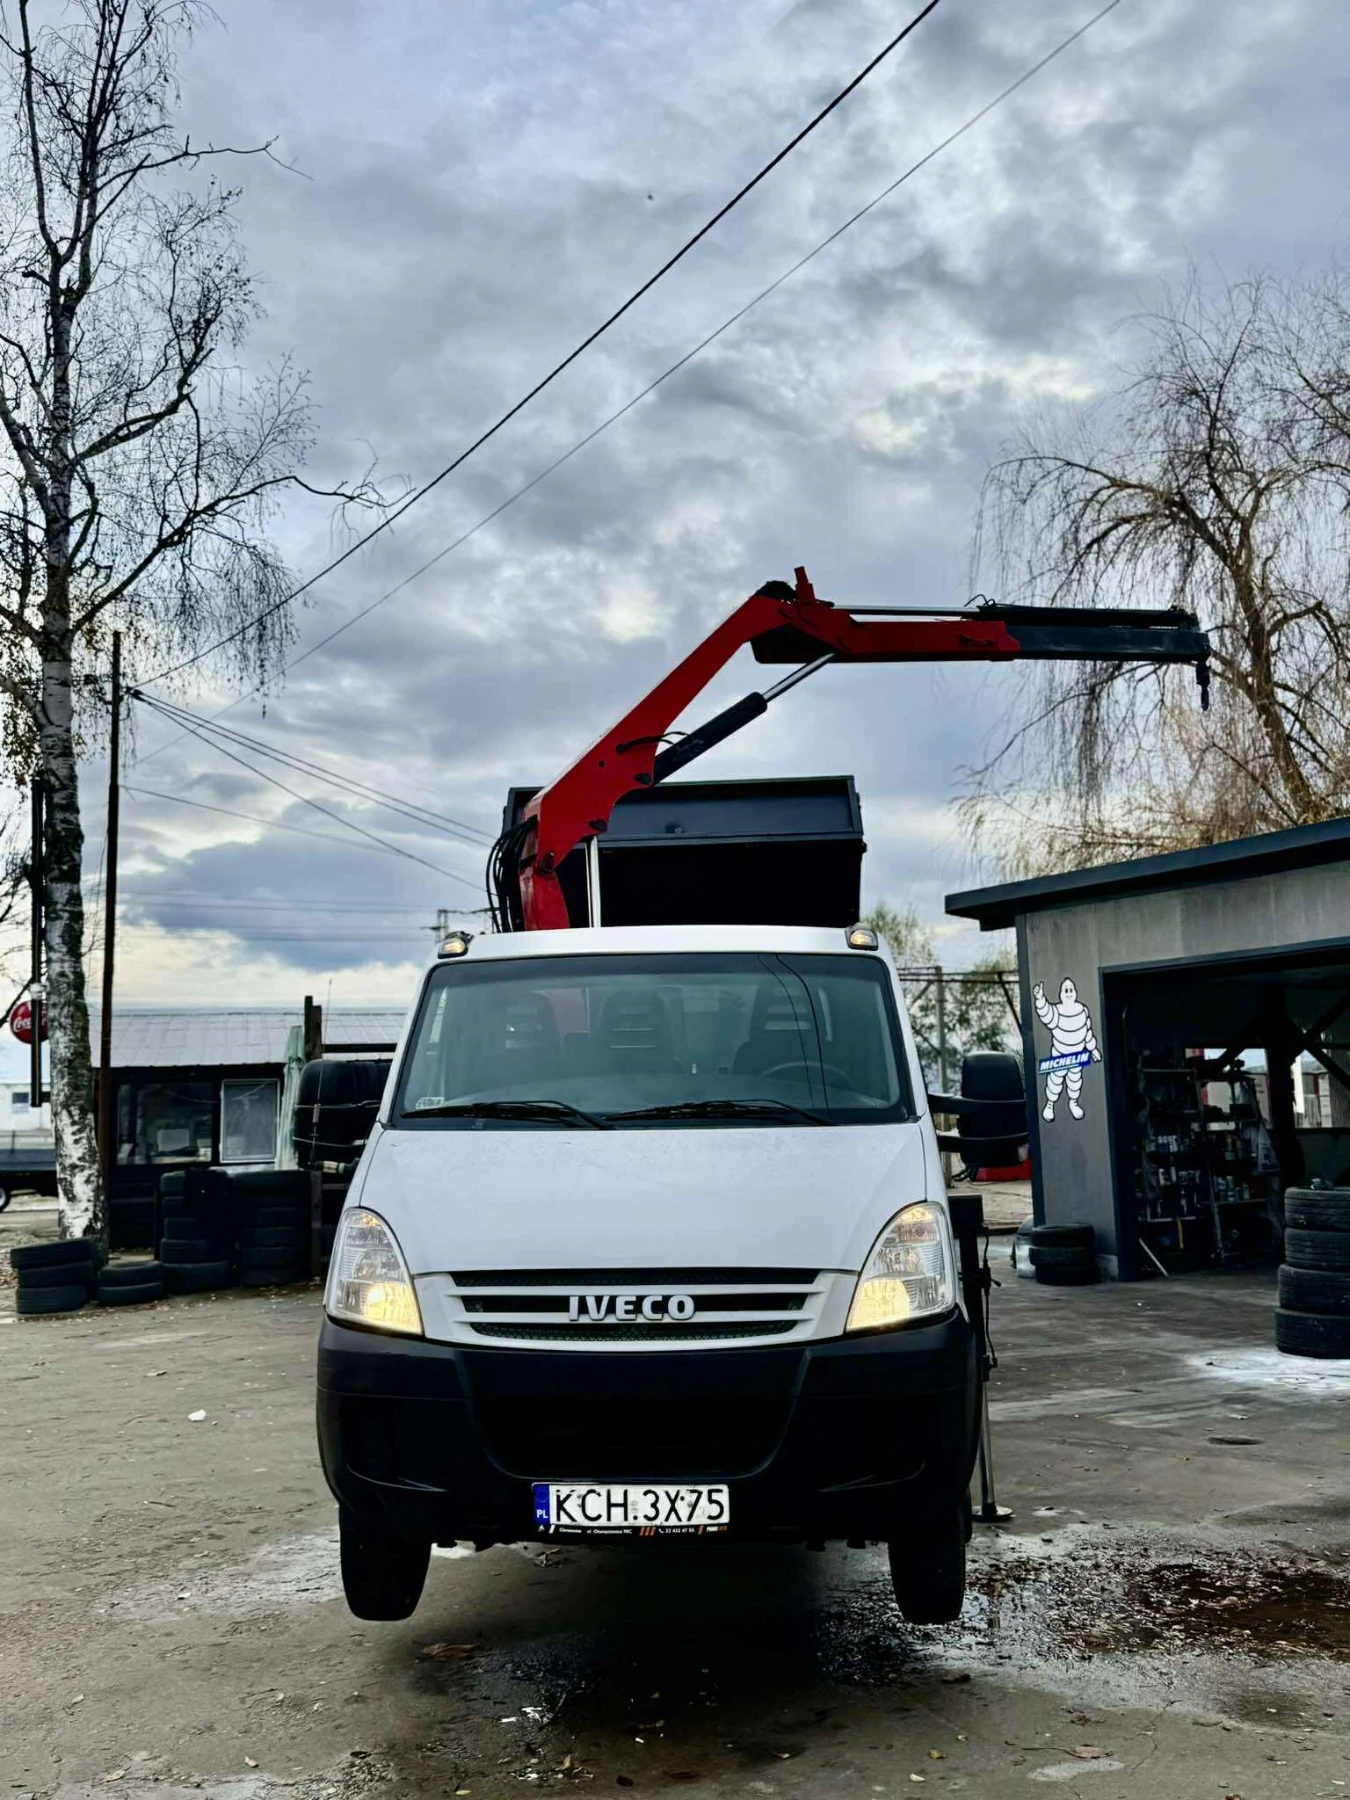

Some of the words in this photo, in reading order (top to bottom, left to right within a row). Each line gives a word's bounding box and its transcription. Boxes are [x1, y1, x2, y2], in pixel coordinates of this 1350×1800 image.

[1040, 1051, 1090, 1071] MICHELIN
[569, 1294, 695, 1321] IVECO
[536, 1509, 549, 1519] PL
